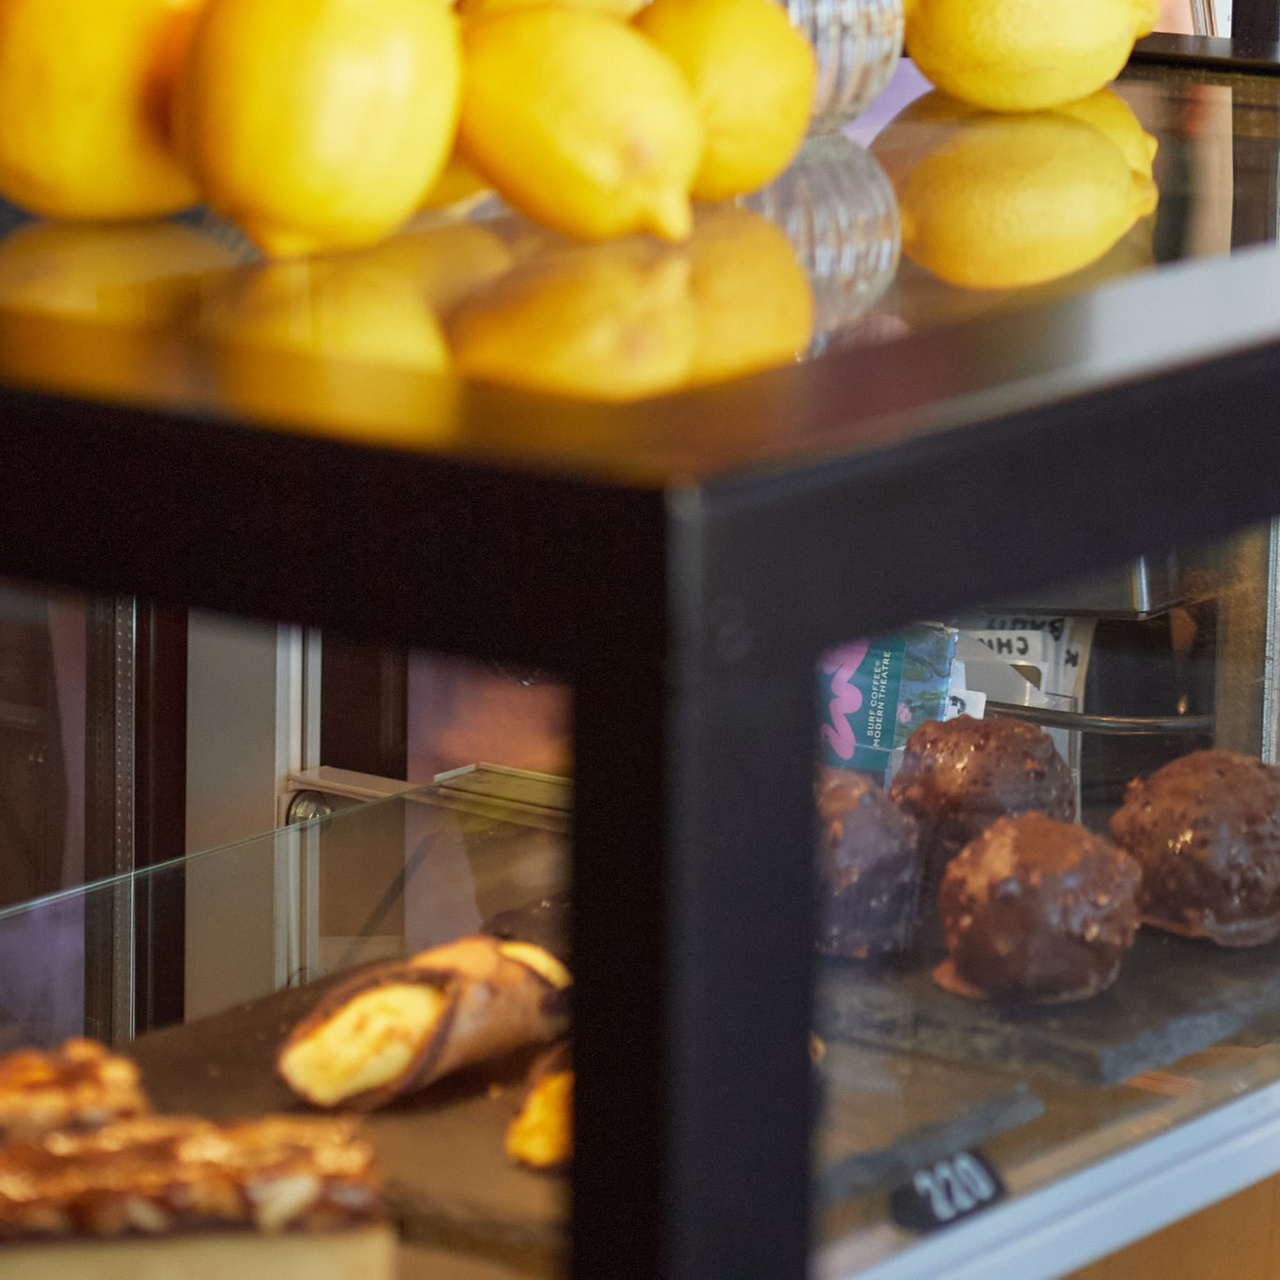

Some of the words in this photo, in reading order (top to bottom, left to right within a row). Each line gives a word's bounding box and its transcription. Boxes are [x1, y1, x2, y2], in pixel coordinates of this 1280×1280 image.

[878, 651, 891, 700] THEATRE
[867, 709, 875, 737] SURF
[873, 701, 885, 748] MODERN
[912, 1151, 998, 1222] 220
